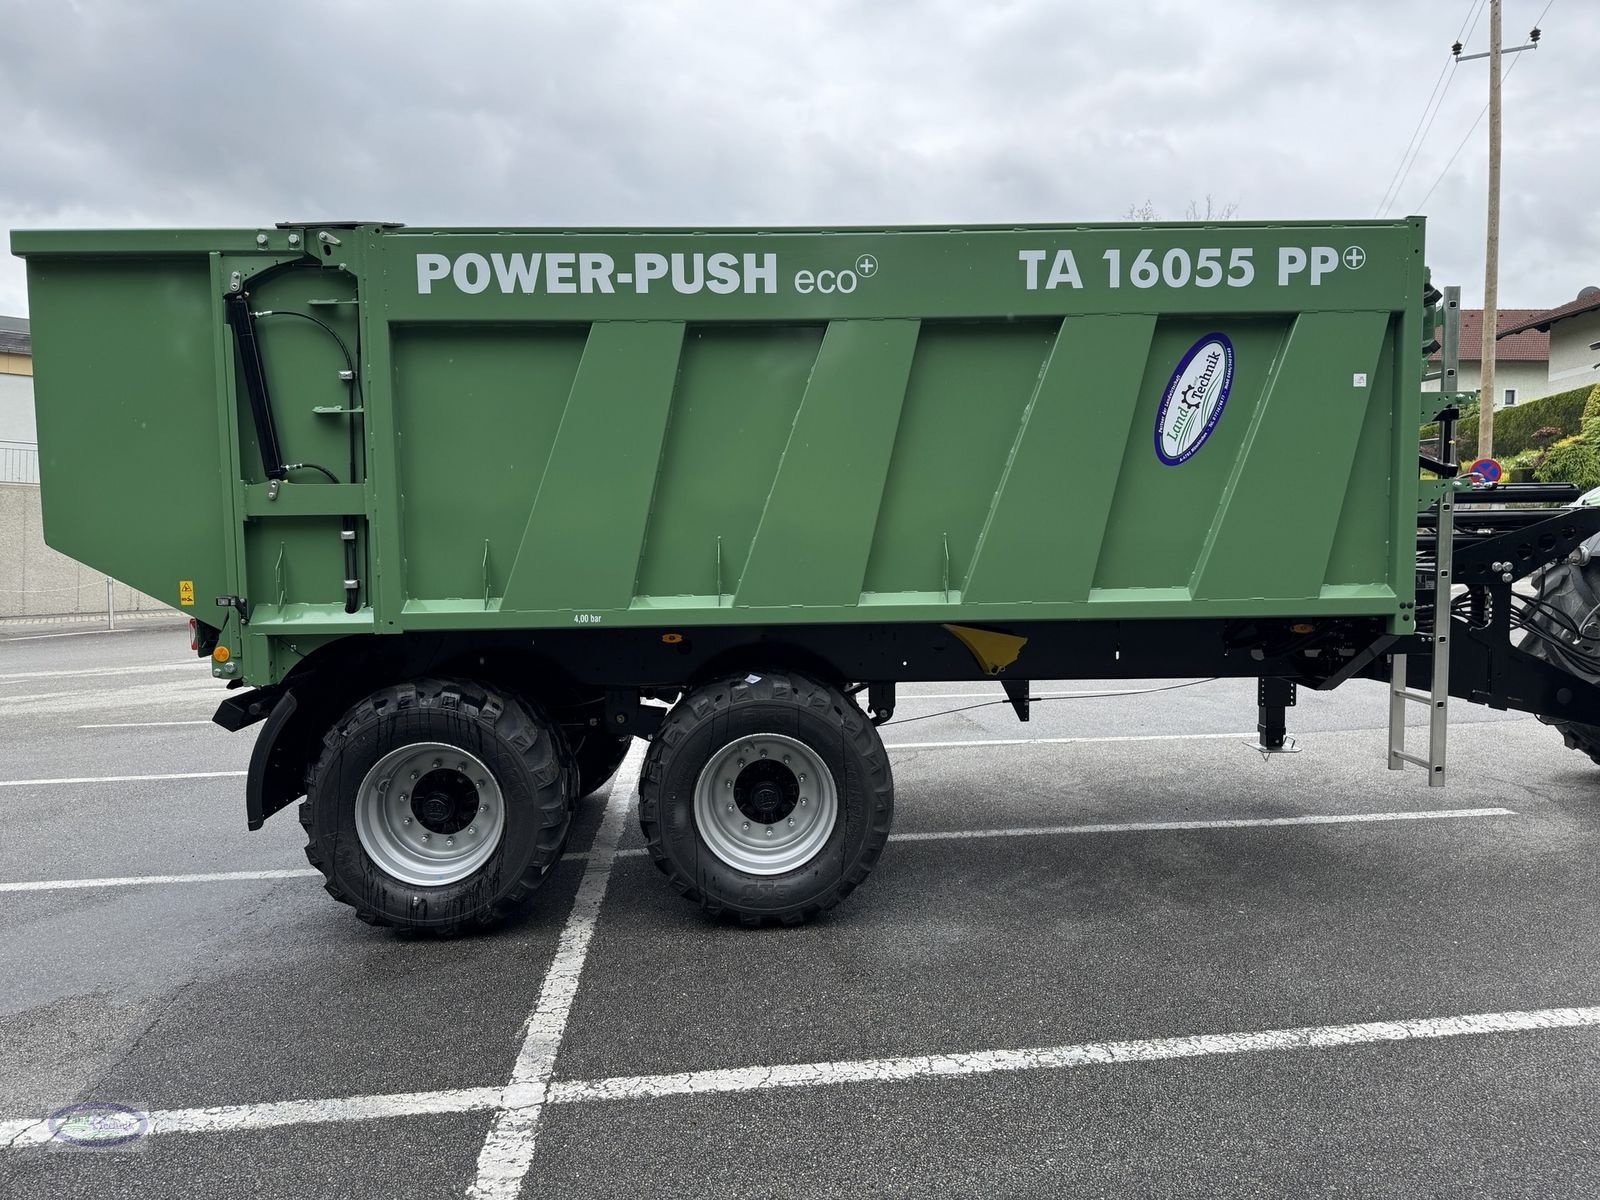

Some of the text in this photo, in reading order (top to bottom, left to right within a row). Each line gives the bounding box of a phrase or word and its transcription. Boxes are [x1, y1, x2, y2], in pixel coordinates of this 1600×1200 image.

[416, 253, 777, 295] POWER-PUSH
[1018, 249, 1083, 290] TA
[1102, 247, 1255, 289] 16055
[1192, 351, 1221, 401] Technik
[1167, 406, 1189, 442] Land
[574, 614, 602, 624] 4,00 bar
